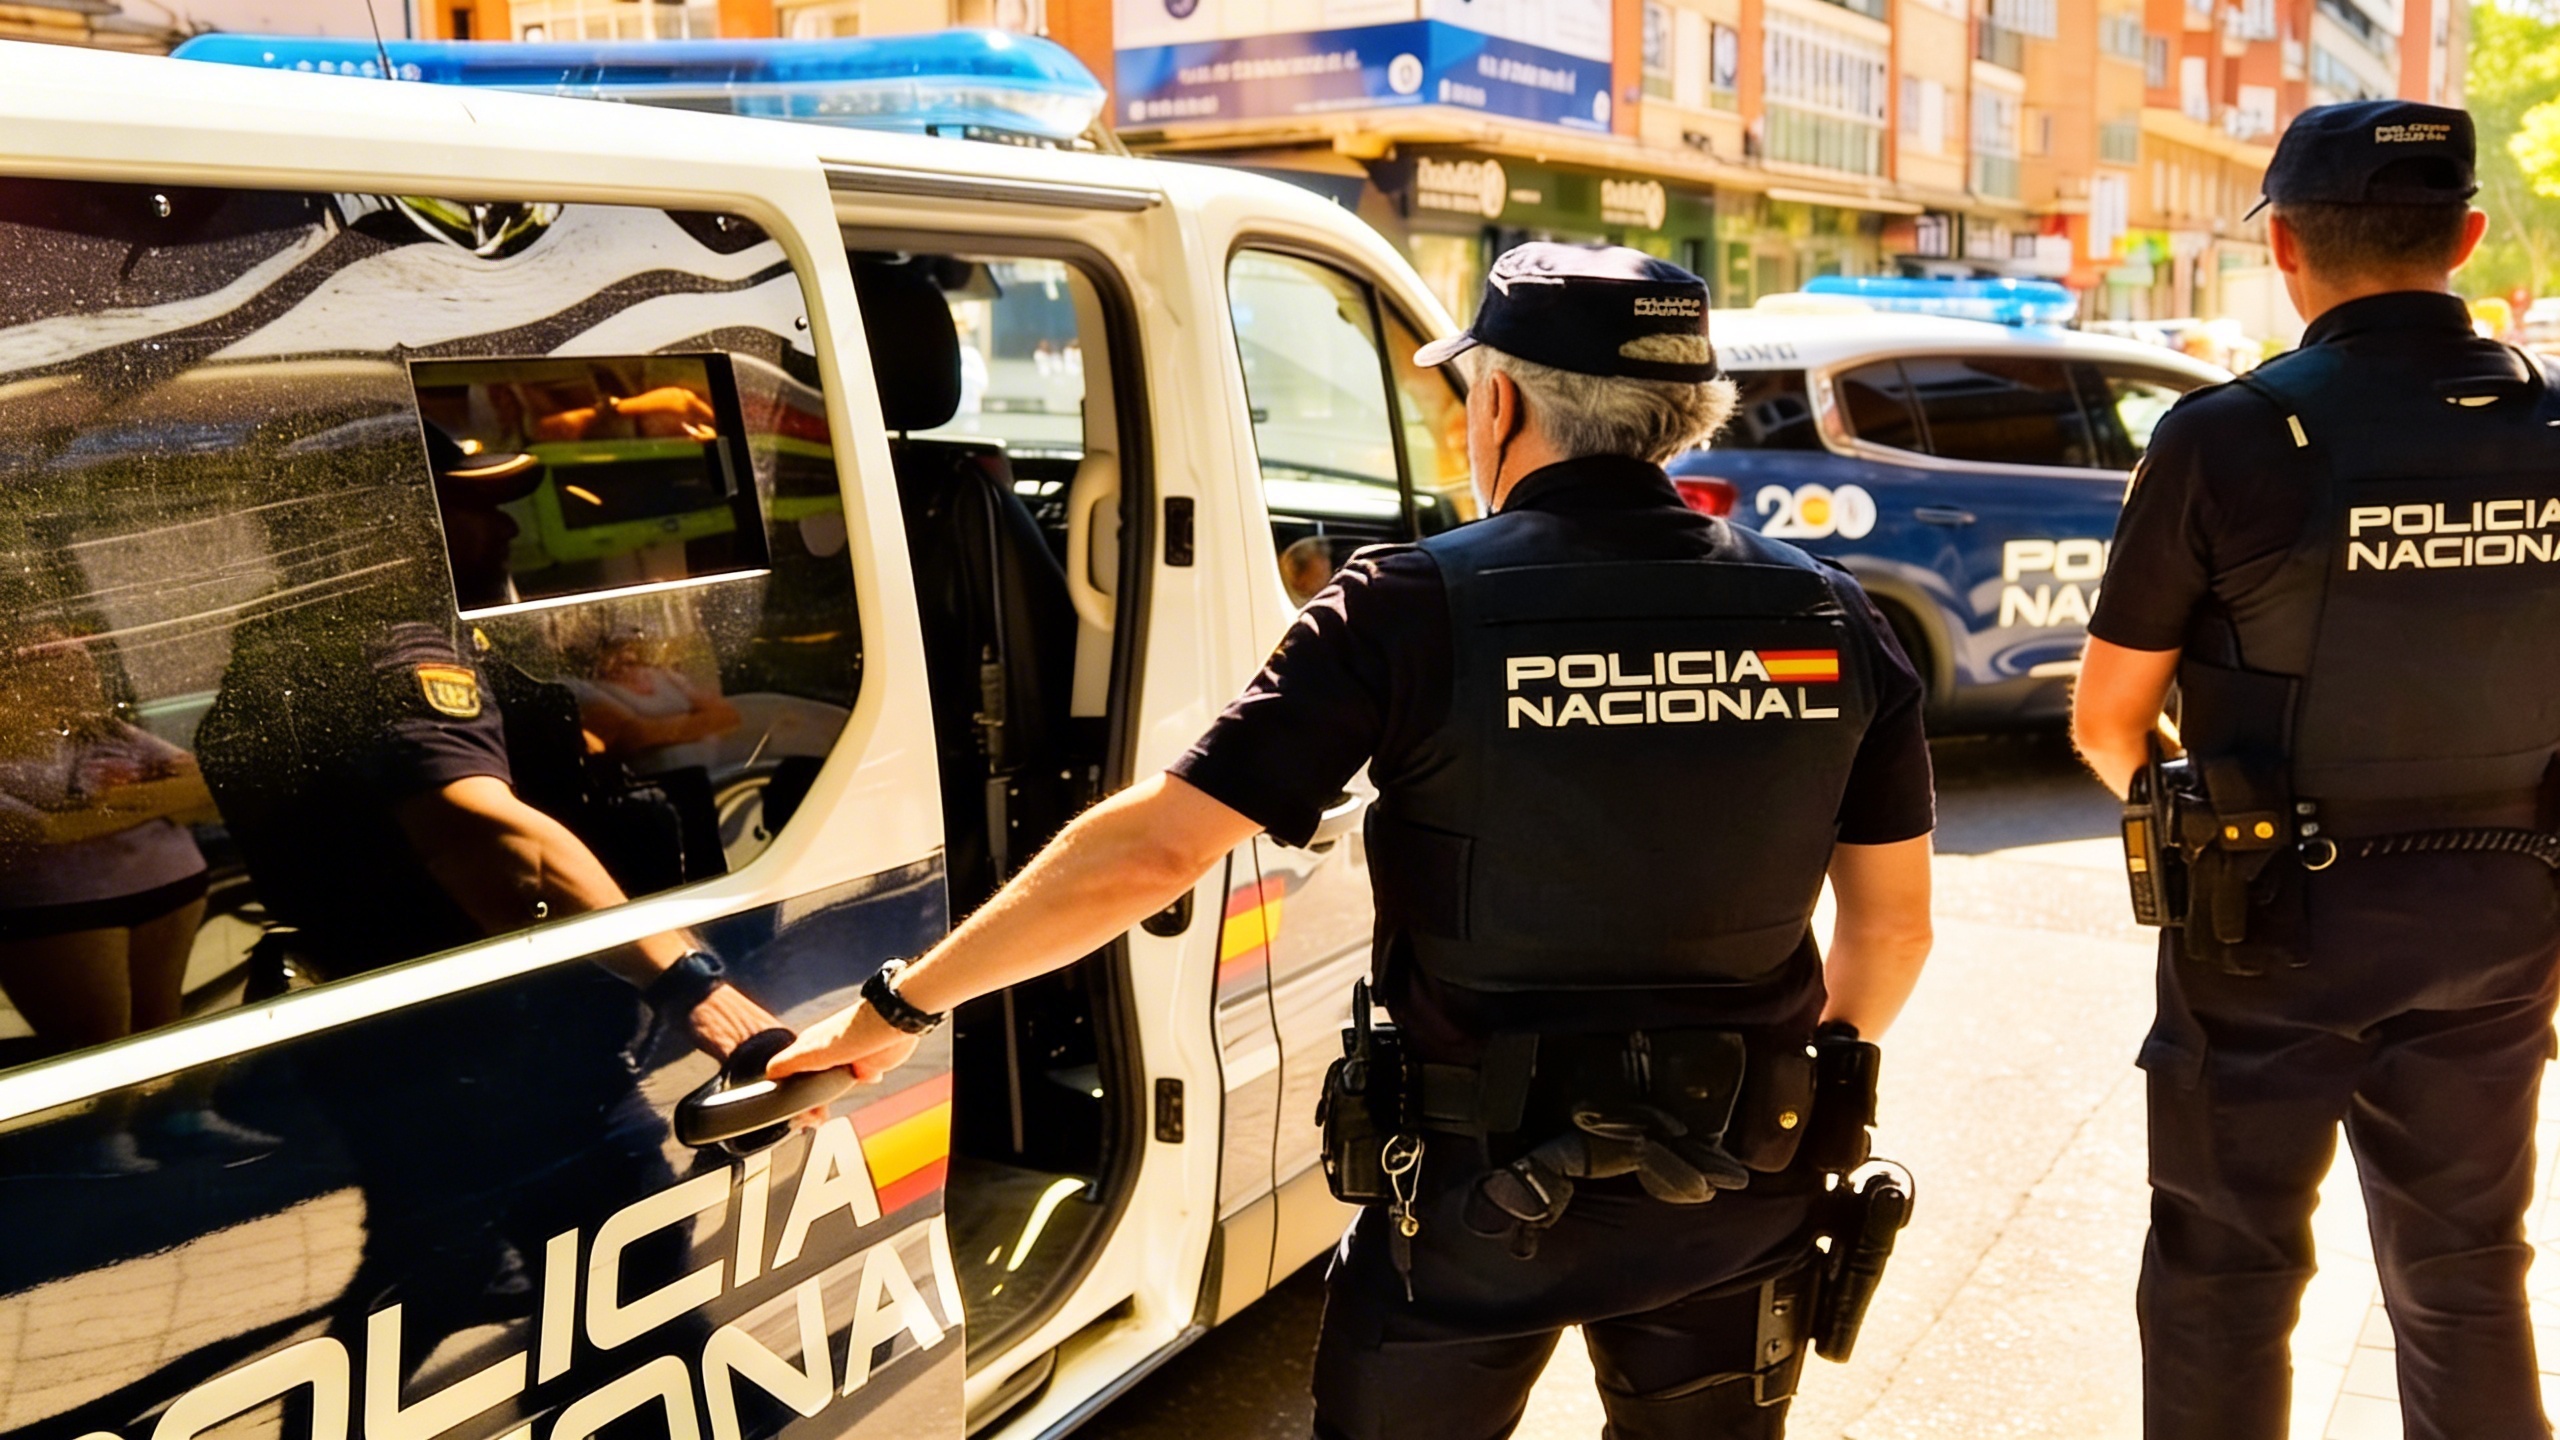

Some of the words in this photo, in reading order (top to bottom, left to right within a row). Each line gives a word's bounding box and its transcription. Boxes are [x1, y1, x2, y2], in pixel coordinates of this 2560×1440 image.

[1755, 483, 1877, 540] 200
[2349, 498, 2560, 537] POLICIA
[2347, 534, 2560, 571] NACION
[1999, 583, 2101, 628] NA
[1506, 650, 1772, 690] POLICIA
[1507, 687, 1839, 728] NACIONAL
[70, 1116, 882, 1440] OLICIA
